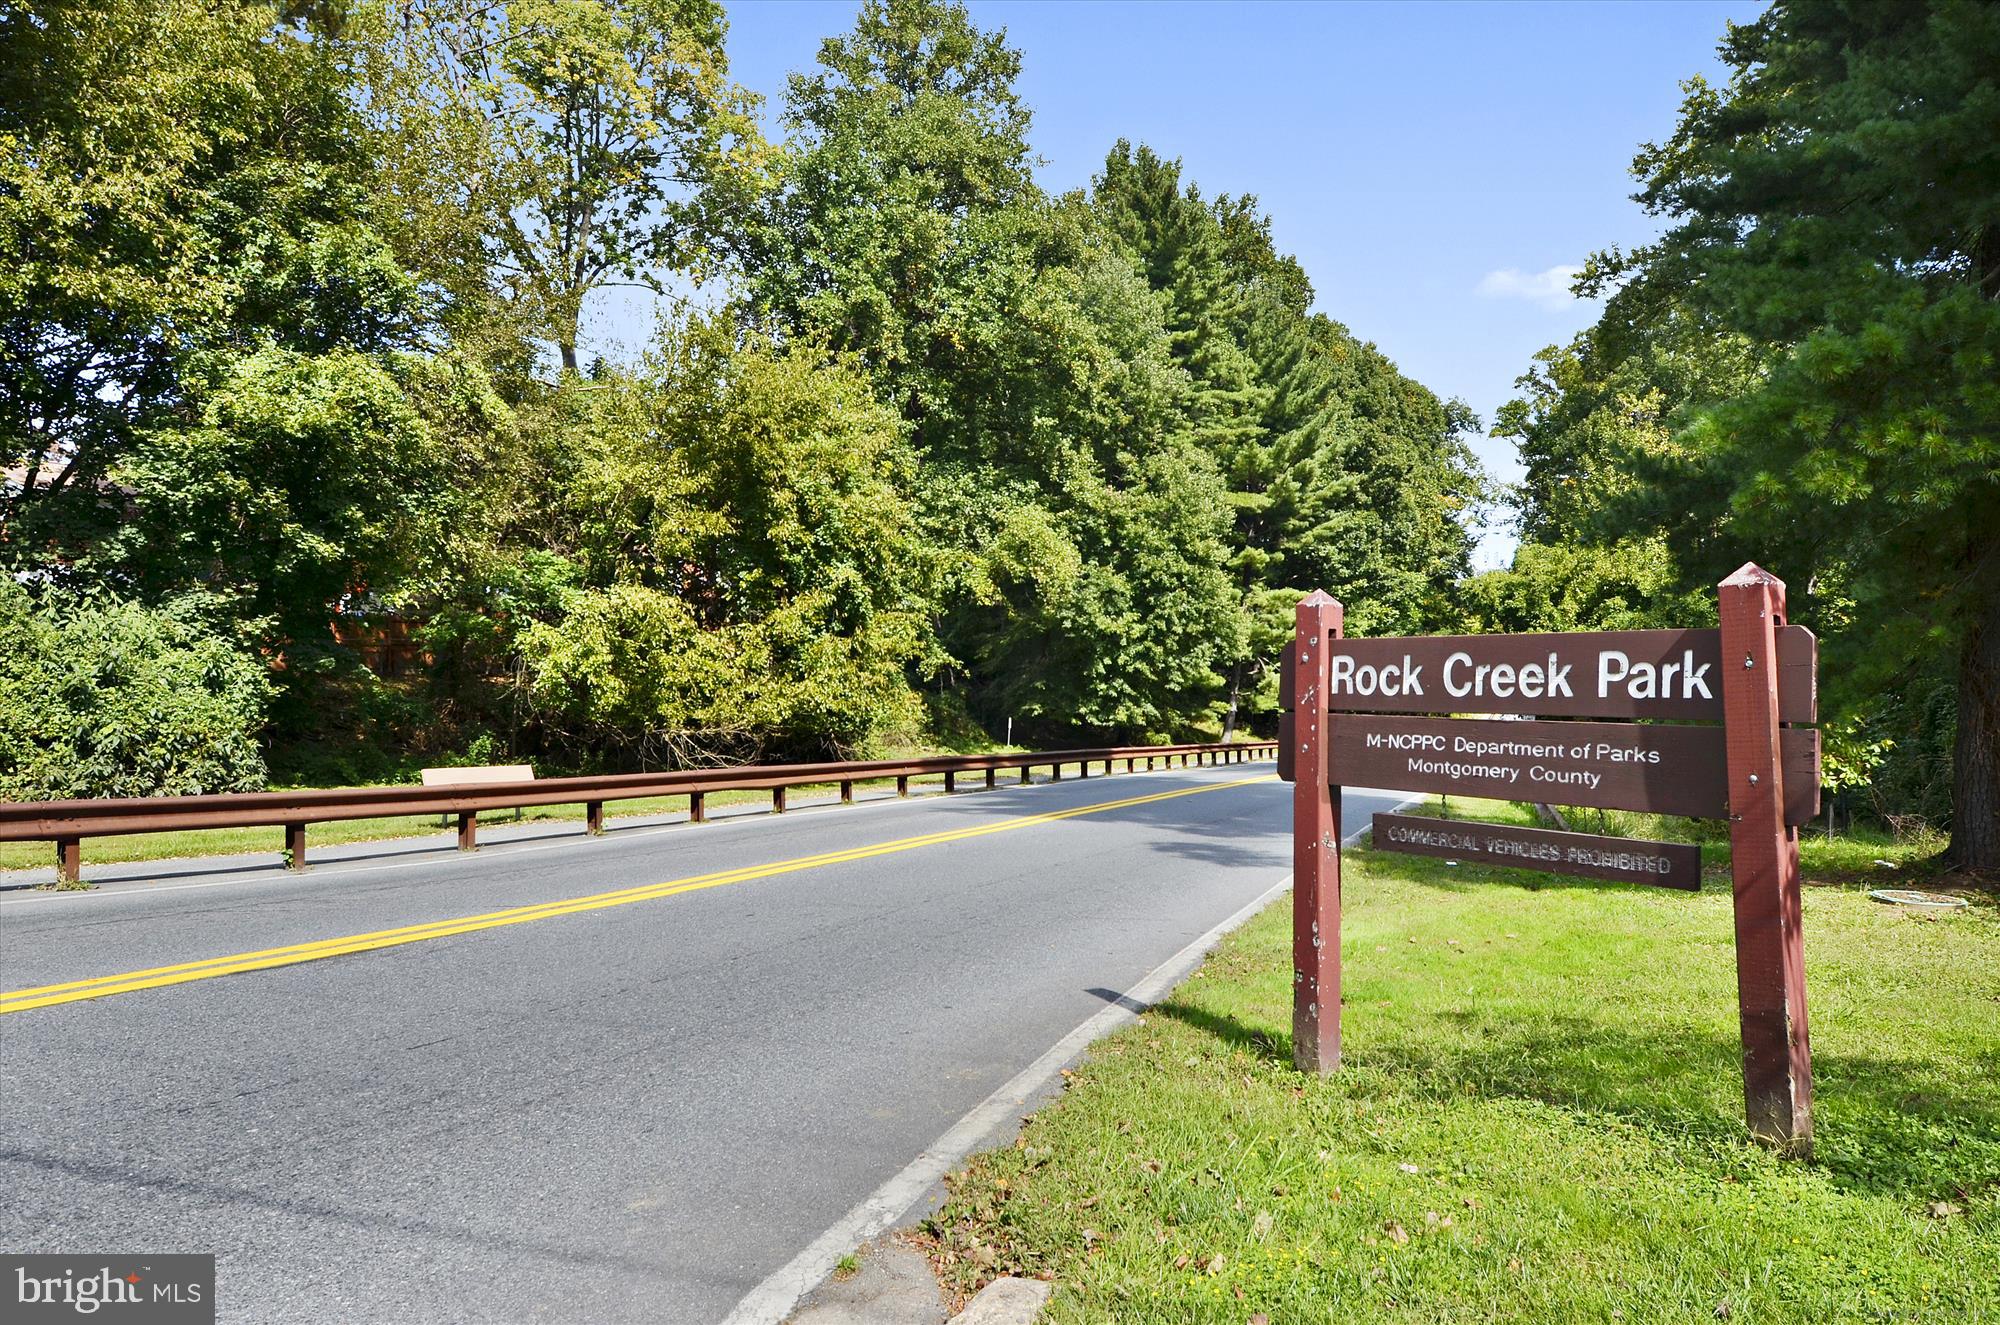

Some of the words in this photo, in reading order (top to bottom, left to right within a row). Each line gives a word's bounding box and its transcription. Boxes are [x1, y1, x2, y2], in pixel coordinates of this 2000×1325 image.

[1331, 654, 1424, 697] Rock
[1443, 651, 1574, 698] Creek
[1598, 649, 1713, 700] Park
[1366, 733, 1446, 751] M-NCPPC
[1454, 736, 1565, 758] Department
[1570, 743, 1592, 760] of
[1596, 743, 1661, 764] Parks
[1408, 758, 1520, 783] Montgomery
[1529, 765, 1602, 789] County
[1387, 825, 1480, 851] COMMERCIAL
[1486, 836, 1561, 862] VEHICLES
[1567, 846, 1671, 874] PROHIBITED
